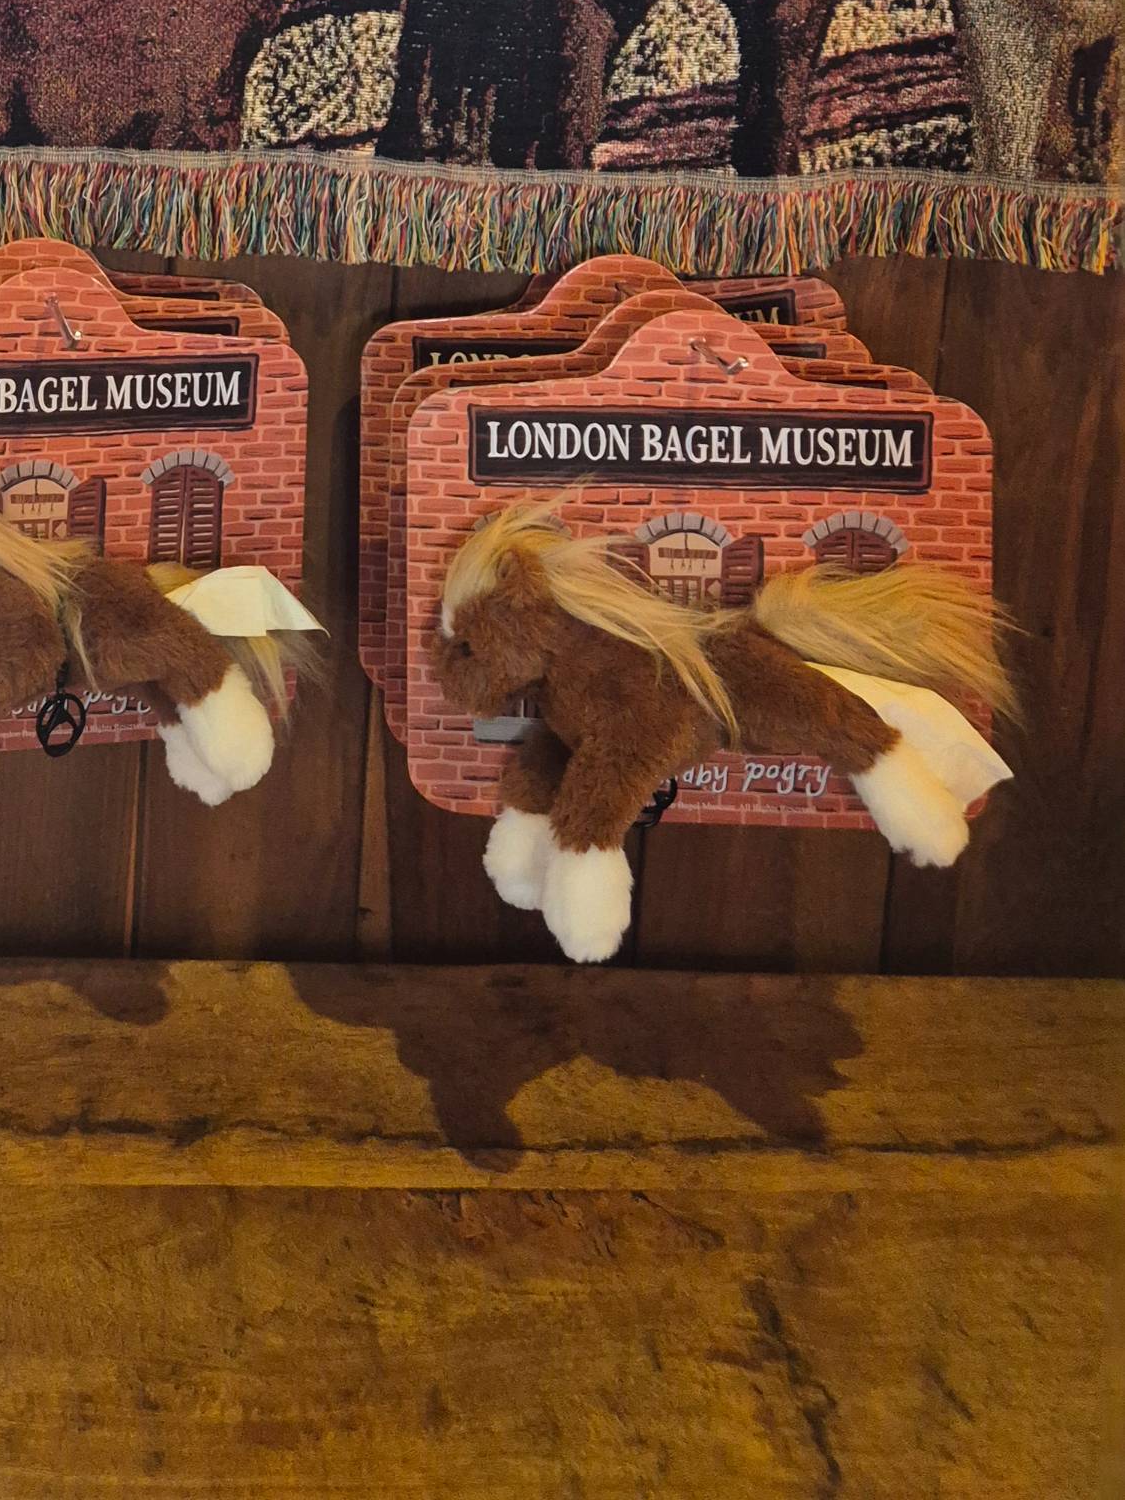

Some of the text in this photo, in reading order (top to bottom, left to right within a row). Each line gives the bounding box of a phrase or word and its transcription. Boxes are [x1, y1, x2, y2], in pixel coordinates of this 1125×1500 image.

[104, 371, 242, 411] MUSEUM
[487, 420, 914, 467] LONDON BAGEL MUSEUM
[661, 761, 831, 797] aby pogry
